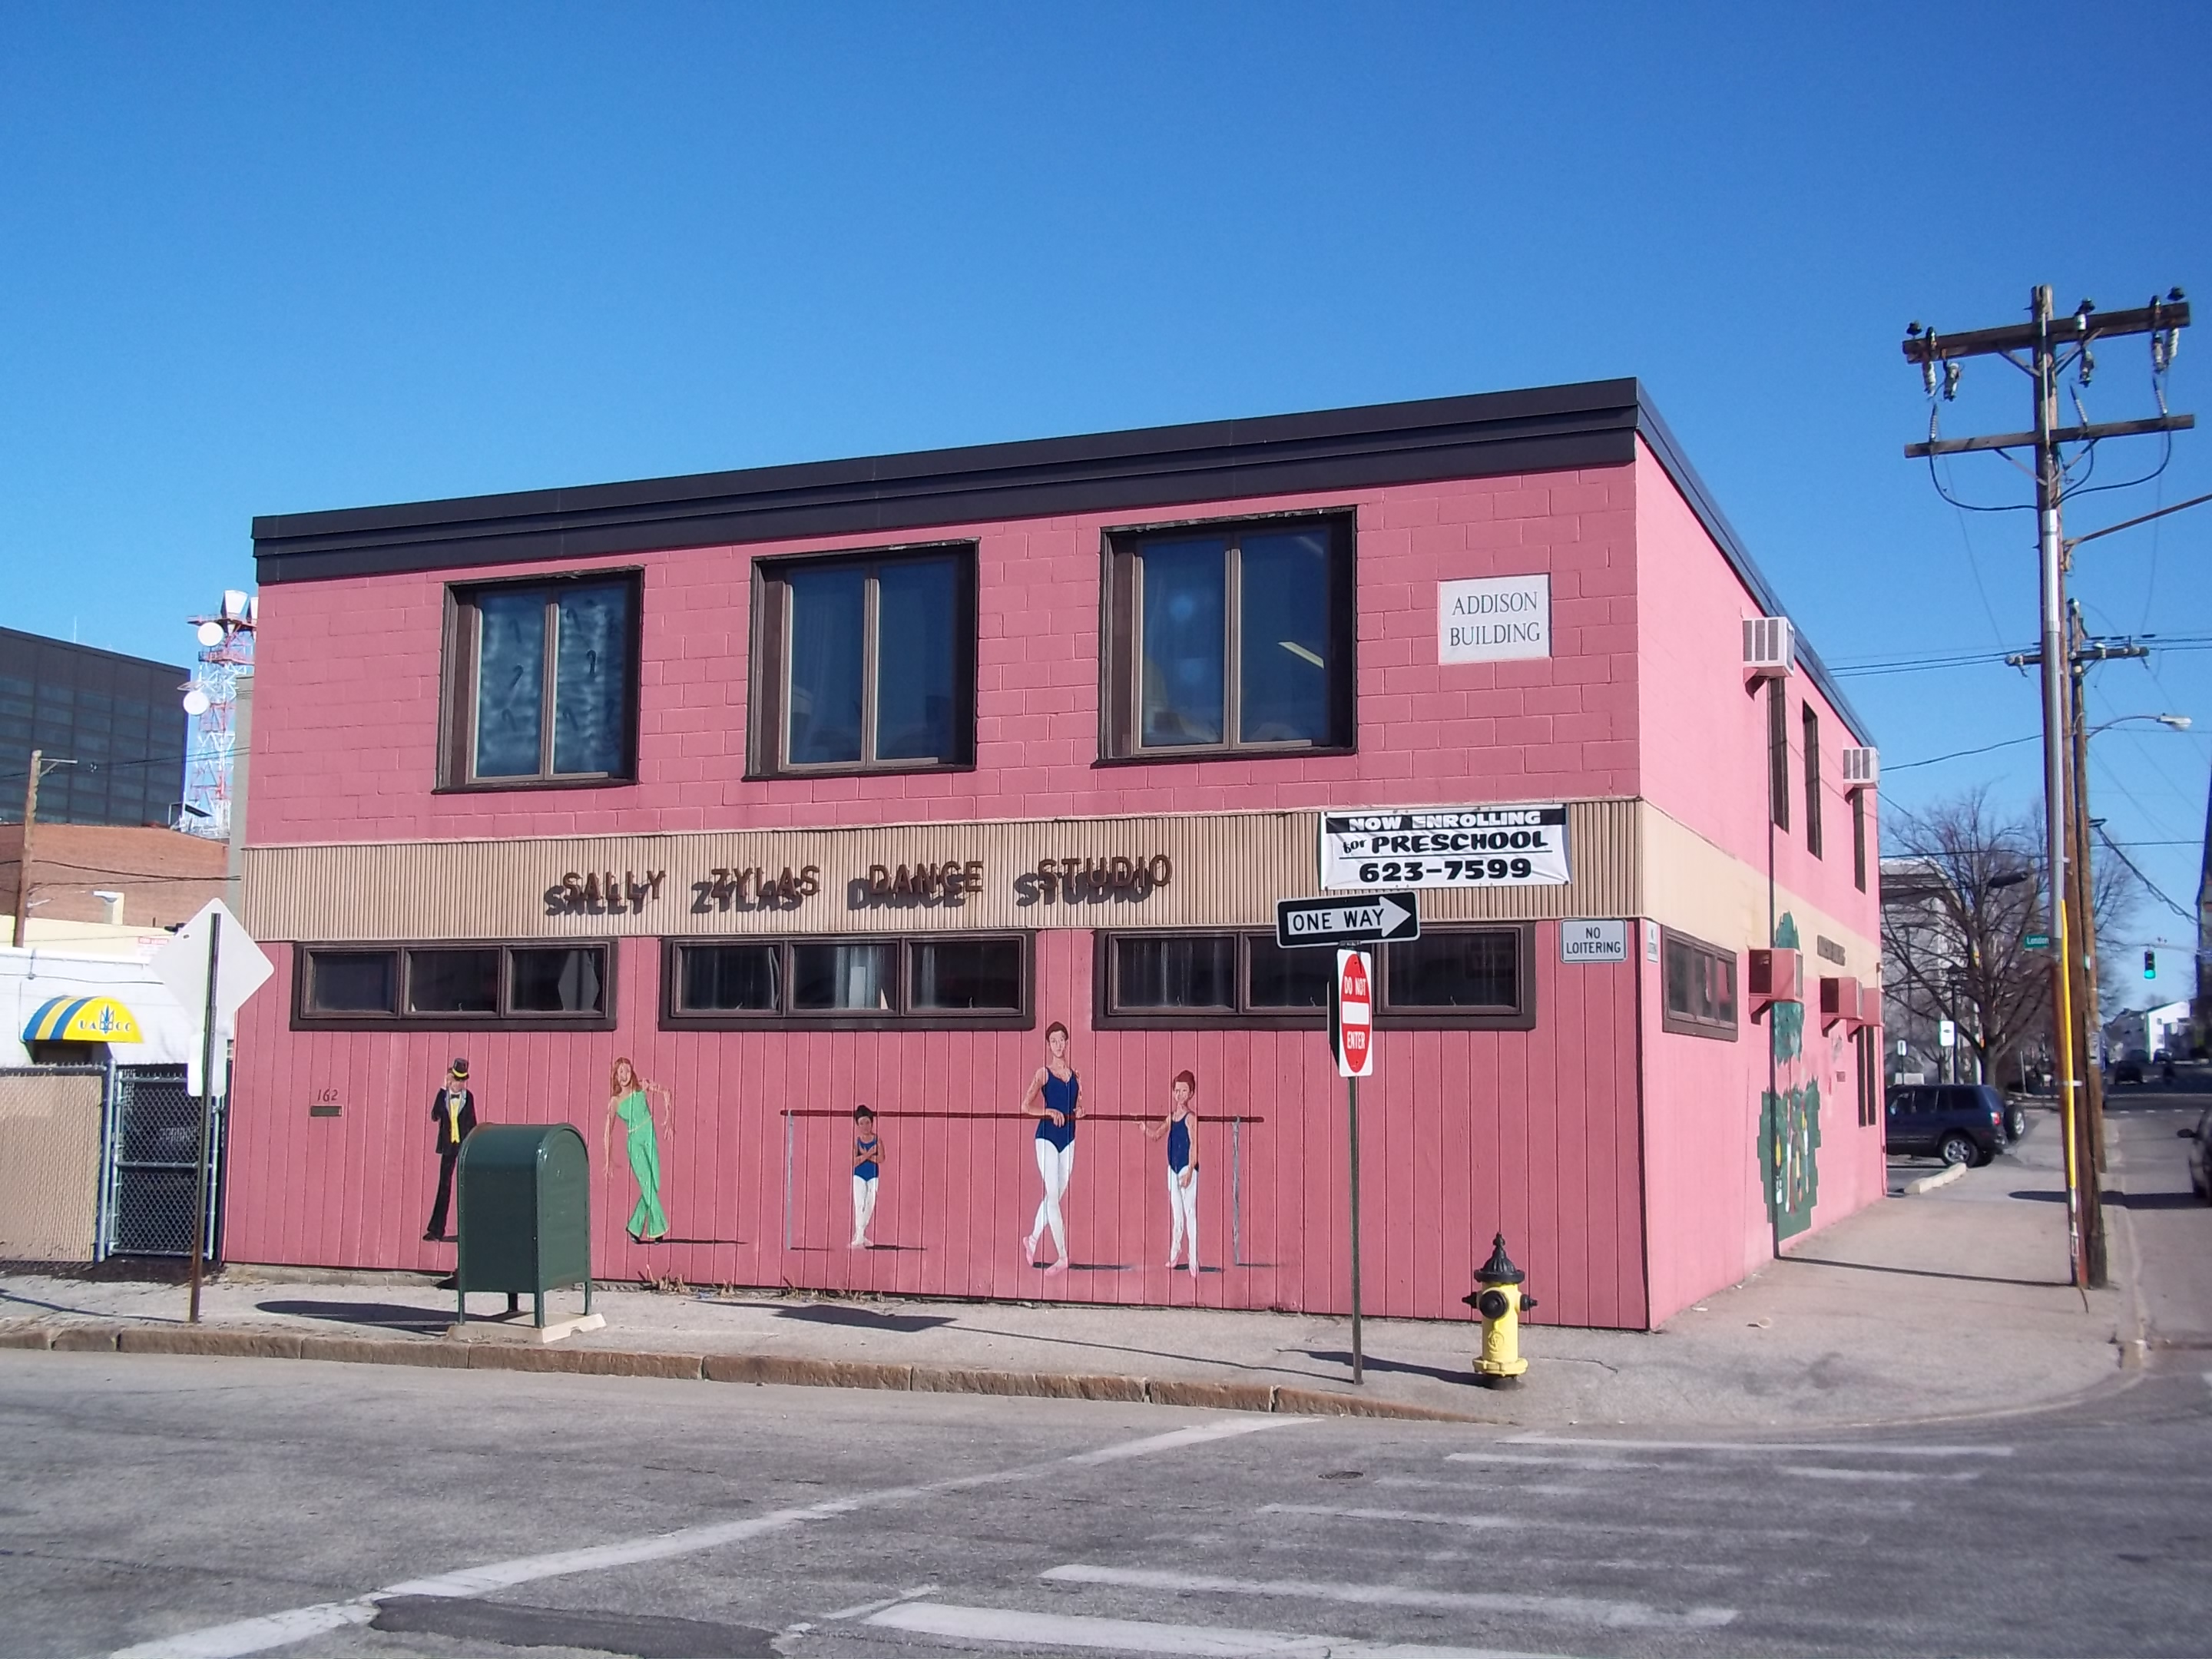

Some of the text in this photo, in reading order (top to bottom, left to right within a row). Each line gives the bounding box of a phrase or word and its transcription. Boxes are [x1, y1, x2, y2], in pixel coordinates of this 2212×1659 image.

[1452, 591, 1538, 615] ADDISON
[1450, 622, 1540, 647] BUILDING
[1349, 811, 1541, 831] NOW ENROLLING
[1371, 830, 1549, 854] PRESCHOOL
[563, 854, 1174, 901] SALLY ZYLAS DANCE STUDIO
[1359, 858, 1532, 882] 623-7599
[1293, 908, 1385, 932] ONE WAY
[1585, 927, 1601, 939] NO
[1566, 942, 1621, 954] LOITERING
[1344, 976, 1367, 996] DO NOT
[1347, 1031, 1366, 1049] ENTER
[316, 1088, 339, 1102] 162
